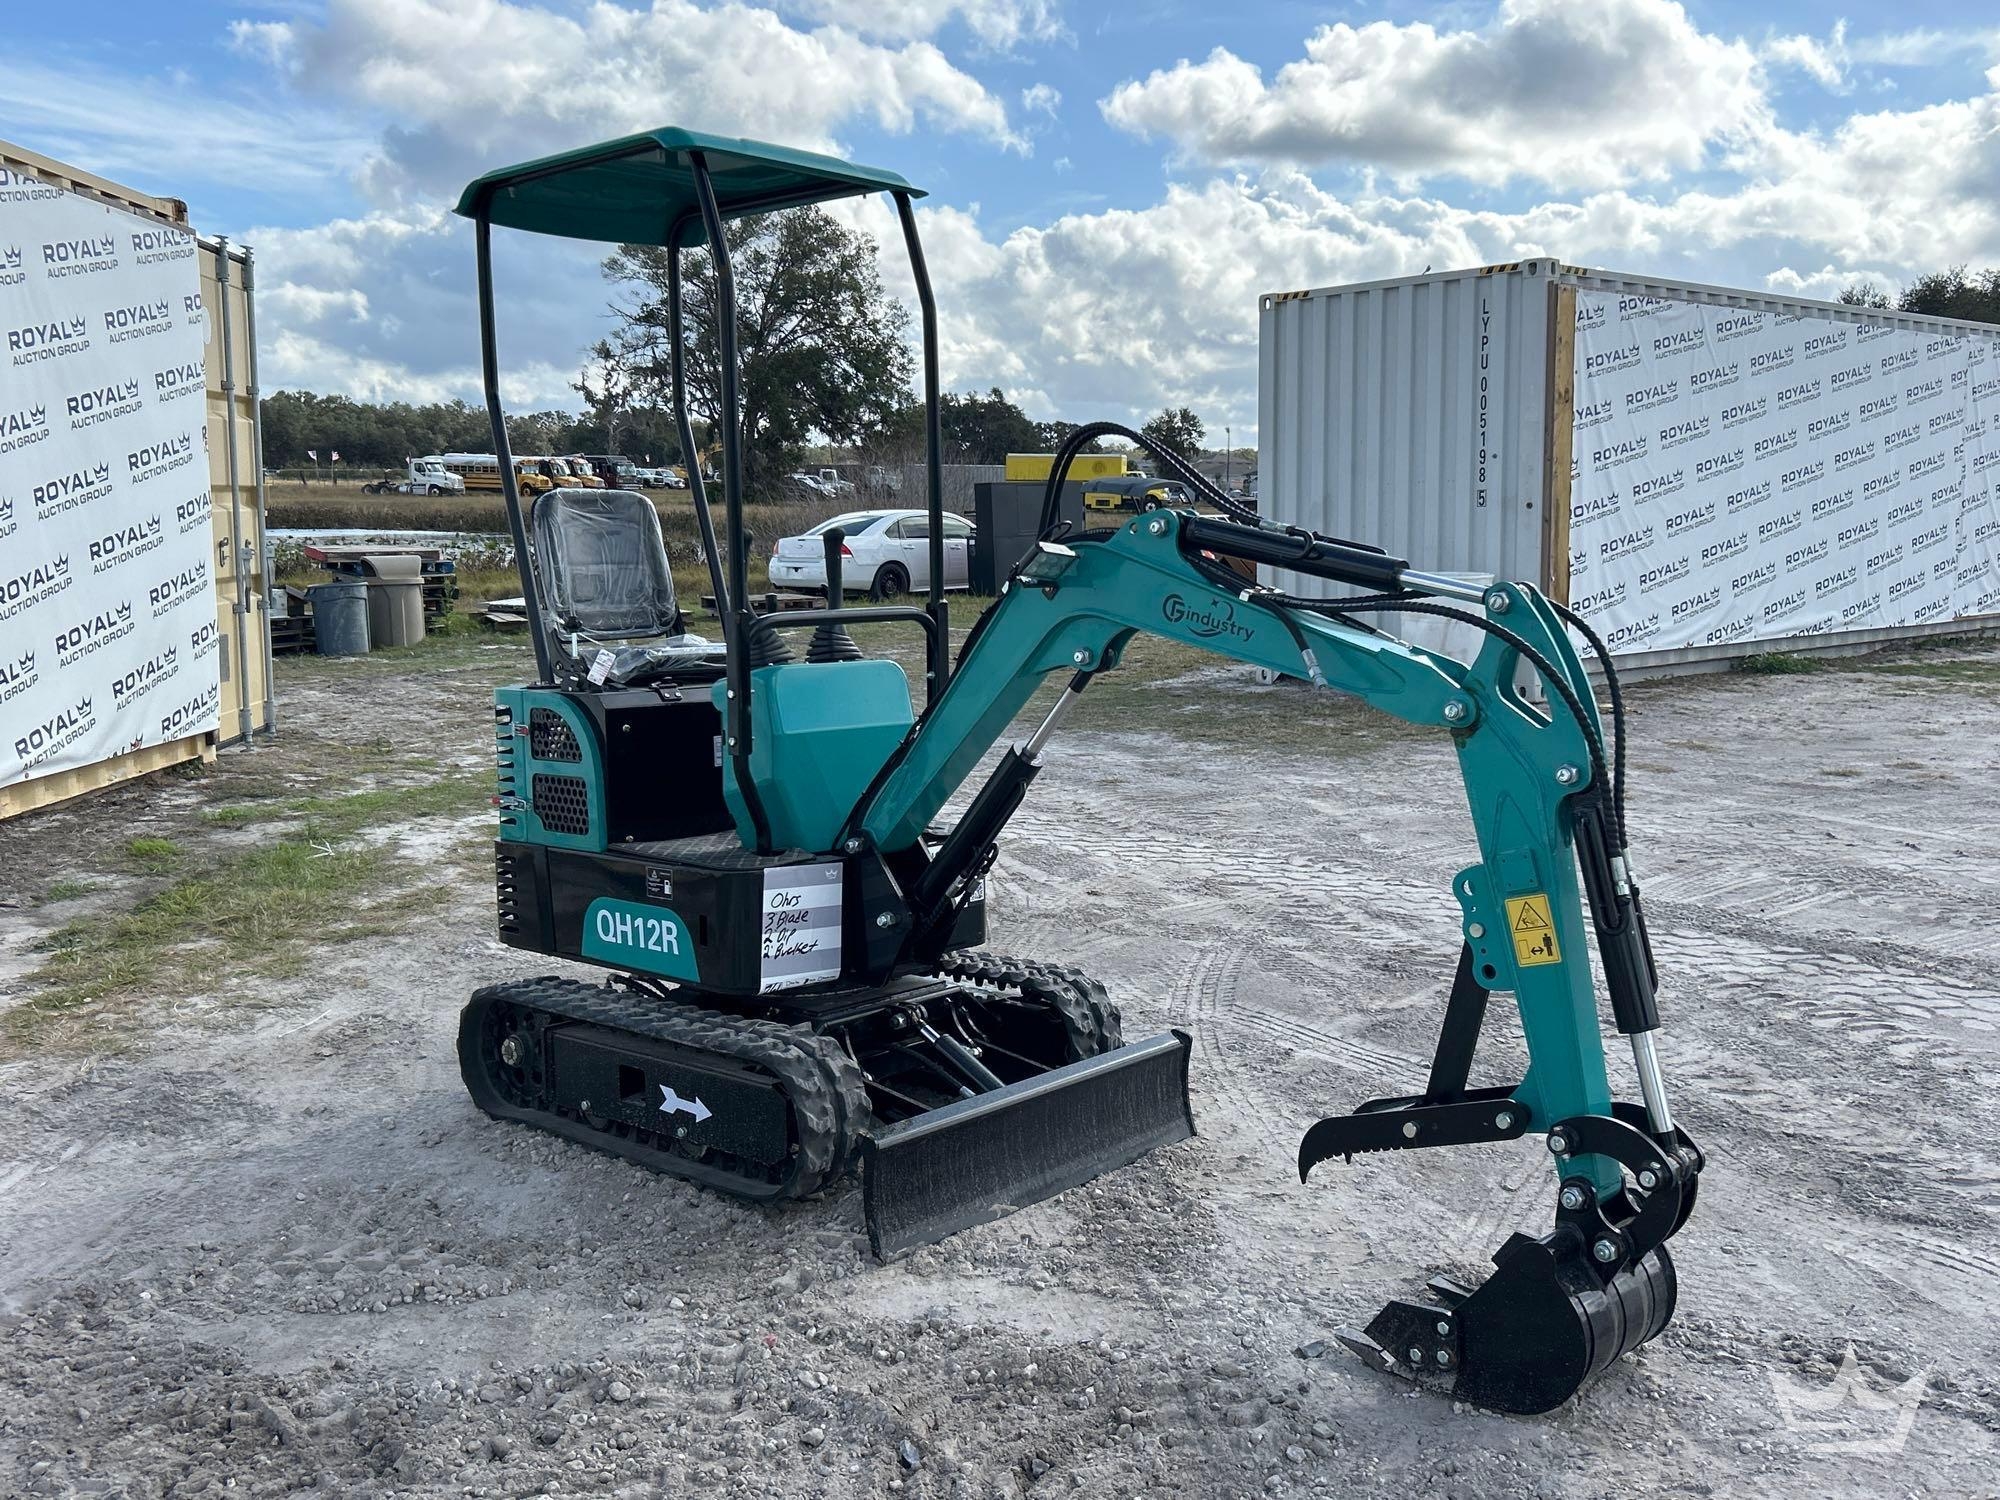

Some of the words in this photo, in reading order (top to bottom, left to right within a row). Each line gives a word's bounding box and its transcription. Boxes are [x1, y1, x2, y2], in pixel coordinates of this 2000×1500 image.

[32, 188, 64, 200] GROUP
[42, 239, 102, 262] ROYAL
[132, 231, 180, 251] ROYAL
[137, 253, 169, 264] AUCTION
[171, 248, 194, 260] GROUP
[47, 264, 88, 279] AUCTION
[88, 259, 118, 273] GROUP
[104, 304, 158, 329] ROYAL
[1620, 310, 1650, 322] AUCTION
[1651, 303, 1672, 315] GROUP
[109, 328, 145, 345] AUCTION
[145, 322, 172, 336] GROUP
[1481, 298, 1490, 370] LYPU
[1716, 315, 1753, 334] ROYAL
[1717, 331, 1743, 342] AUCTION
[1744, 325, 1763, 336] GROUP
[7, 322, 72, 350] ROYAL
[1653, 331, 1693, 351] ROYAL
[1805, 334, 1837, 352] ROYAL
[1926, 338, 1954, 354] ROYAL
[12, 348, 55, 367] AUCTION
[57, 340, 90, 356] GROUP
[1586, 349, 1628, 369] ROYAL
[1655, 348, 1683, 360] AUCTION
[1684, 340, 1705, 352] GROUP
[1750, 350, 1784, 368] ROYAL
[1881, 351, 1910, 368] ROYAL
[155, 362, 201, 389] ROYAL
[1588, 366, 1616, 379] AUCTION
[1618, 358, 1641, 370] GROUP
[1690, 367, 1728, 386] ROYAL
[1751, 365, 1775, 377] AUCTION
[1776, 358, 1794, 369] GROUP
[1831, 367, 1862, 385] ROYAL
[159, 385, 191, 404] AUCTION
[1626, 385, 1667, 406] ROYAL
[1692, 383, 1718, 395] AUCTION
[1719, 376, 1740, 387] GROUP
[1778, 383, 1811, 402] ROYAL
[1906, 382, 1934, 399] ROYAL
[1972, 380, 1997, 396] ROYAL
[67, 385, 127, 415] ROYAL
[1627, 402, 1656, 415] AUCTION
[1657, 394, 1678, 406] GROUP
[1859, 397, 1890, 416] ROYAL
[71, 410, 112, 431] AUCTION
[113, 401, 142, 418] GROUP
[1590, 414, 1613, 427] GROUP
[1722, 401, 1757, 421] ROYAL
[1723, 417, 1748, 430] AUCTION
[1748, 410, 1767, 421] GROUP
[1928, 411, 1955, 429] ROYAL
[1479, 376, 1487, 482] 005198
[1660, 420, 1699, 441] ROYAL
[1808, 415, 1841, 434] ROYAL
[17, 429, 49, 448] GROUP
[1661, 437, 1689, 451] AUCTION
[1689, 429, 1710, 441] GROUP
[1754, 433, 1788, 453] ROYAL
[1885, 427, 1911, 446] ROYAL
[128, 440, 180, 471] ROYAL
[1593, 441, 1636, 463] ROYAL
[1594, 458, 1624, 473] AUCTION
[1626, 449, 1648, 462] GROUP
[1834, 445, 1865, 464] ROYAL
[1973, 450, 1998, 468] ROYAL
[132, 464, 168, 486] AUCTION
[168, 454, 193, 470] GROUP
[1696, 453, 1733, 474] ROYAL
[1697, 469, 1724, 483] AUCTION
[1725, 461, 1745, 473] GROUP
[1909, 456, 1937, 474] ROYAL
[1781, 465, 1815, 485] ROYAL
[1863, 474, 1894, 493] ROYAL
[33, 471, 95, 506] ROYAL
[1633, 475, 1673, 497] ROYAL
[1634, 491, 1663, 506] AUCTION
[1662, 482, 1685, 495] GROUP
[1728, 485, 1761, 506] ROYAL
[38, 497, 78, 522] AUCTION
[79, 485, 112, 504] GROUP
[1478, 490, 1486, 507] 5
[1728, 501, 1752, 515] AUCTION
[1753, 493, 1771, 505] GROUP
[1812, 494, 1844, 514] ROYAL
[1596, 506, 1620, 519] GROUP
[1666, 508, 1704, 530] ROYAL
[1886, 503, 1914, 521] ROYAL
[1667, 524, 1694, 539] AUCTION
[1694, 515, 1716, 528] GROUP
[1758, 515, 1792, 536] ROYAL
[1838, 523, 1869, 543] ROYAL
[89, 524, 149, 560] ROYAL
[1600, 532, 1642, 555] ROYAL
[1911, 528, 1939, 548] ROYAL
[93, 549, 134, 575] AUCTION
[135, 536, 164, 555] GROUP
[1602, 549, 1631, 564] AUCTION
[1632, 539, 1654, 552] GROUP
[1702, 538, 1739, 560] ROYAL
[1702, 554, 1728, 569] AUCTION
[1729, 544, 1748, 558] GROUP
[1786, 545, 1818, 566] ROYAL
[1867, 549, 1894, 569] ROYAL
[1640, 562, 1678, 586] ROYAL
[1640, 579, 1668, 595] AUCTION
[1669, 569, 1689, 583] GROUP
[1733, 568, 1765, 590] ROYAL
[1816, 571, 1848, 592] ROYAL
[1957, 563, 1982, 582] ROYAL
[41, 577, 72, 600] GROUP
[150, 569, 196, 606] ROYAL
[1889, 576, 1917, 596] ROYAL
[153, 594, 185, 620] AUCTION
[185, 580, 208, 599] GROUP
[1571, 588, 1614, 614] ROYAL
[1672, 593, 1709, 616] ROYAL
[1764, 595, 1795, 617] ROYAL
[1842, 598, 1872, 620] ROYAL
[1915, 600, 1942, 620] ROYAL
[1673, 609, 1699, 625] AUCTION
[1700, 599, 1720, 613] GROUP
[56, 612, 117, 654] ROYAL
[1607, 620, 1650, 645] ROYAL
[1707, 620, 1742, 644] ROYAL
[60, 639, 101, 669] AUCTION
[102, 622, 135, 645] GROUP
[4, 674, 38, 701] GROUP
[112, 656, 164, 699] ROYAL
[116, 682, 150, 713] AUCTION
[151, 665, 178, 688] GROUP
[162, 694, 208, 734] ROYAL
[197, 701, 218, 723] GROUP
[15, 710, 78, 759] ROYAL
[23, 739, 64, 771] AUCTION
[66, 718, 96, 744] GROUP
[777, 910, 808, 929] Blade
[596, 910, 679, 955] QH12R
[774, 939, 818, 959] Bucket
